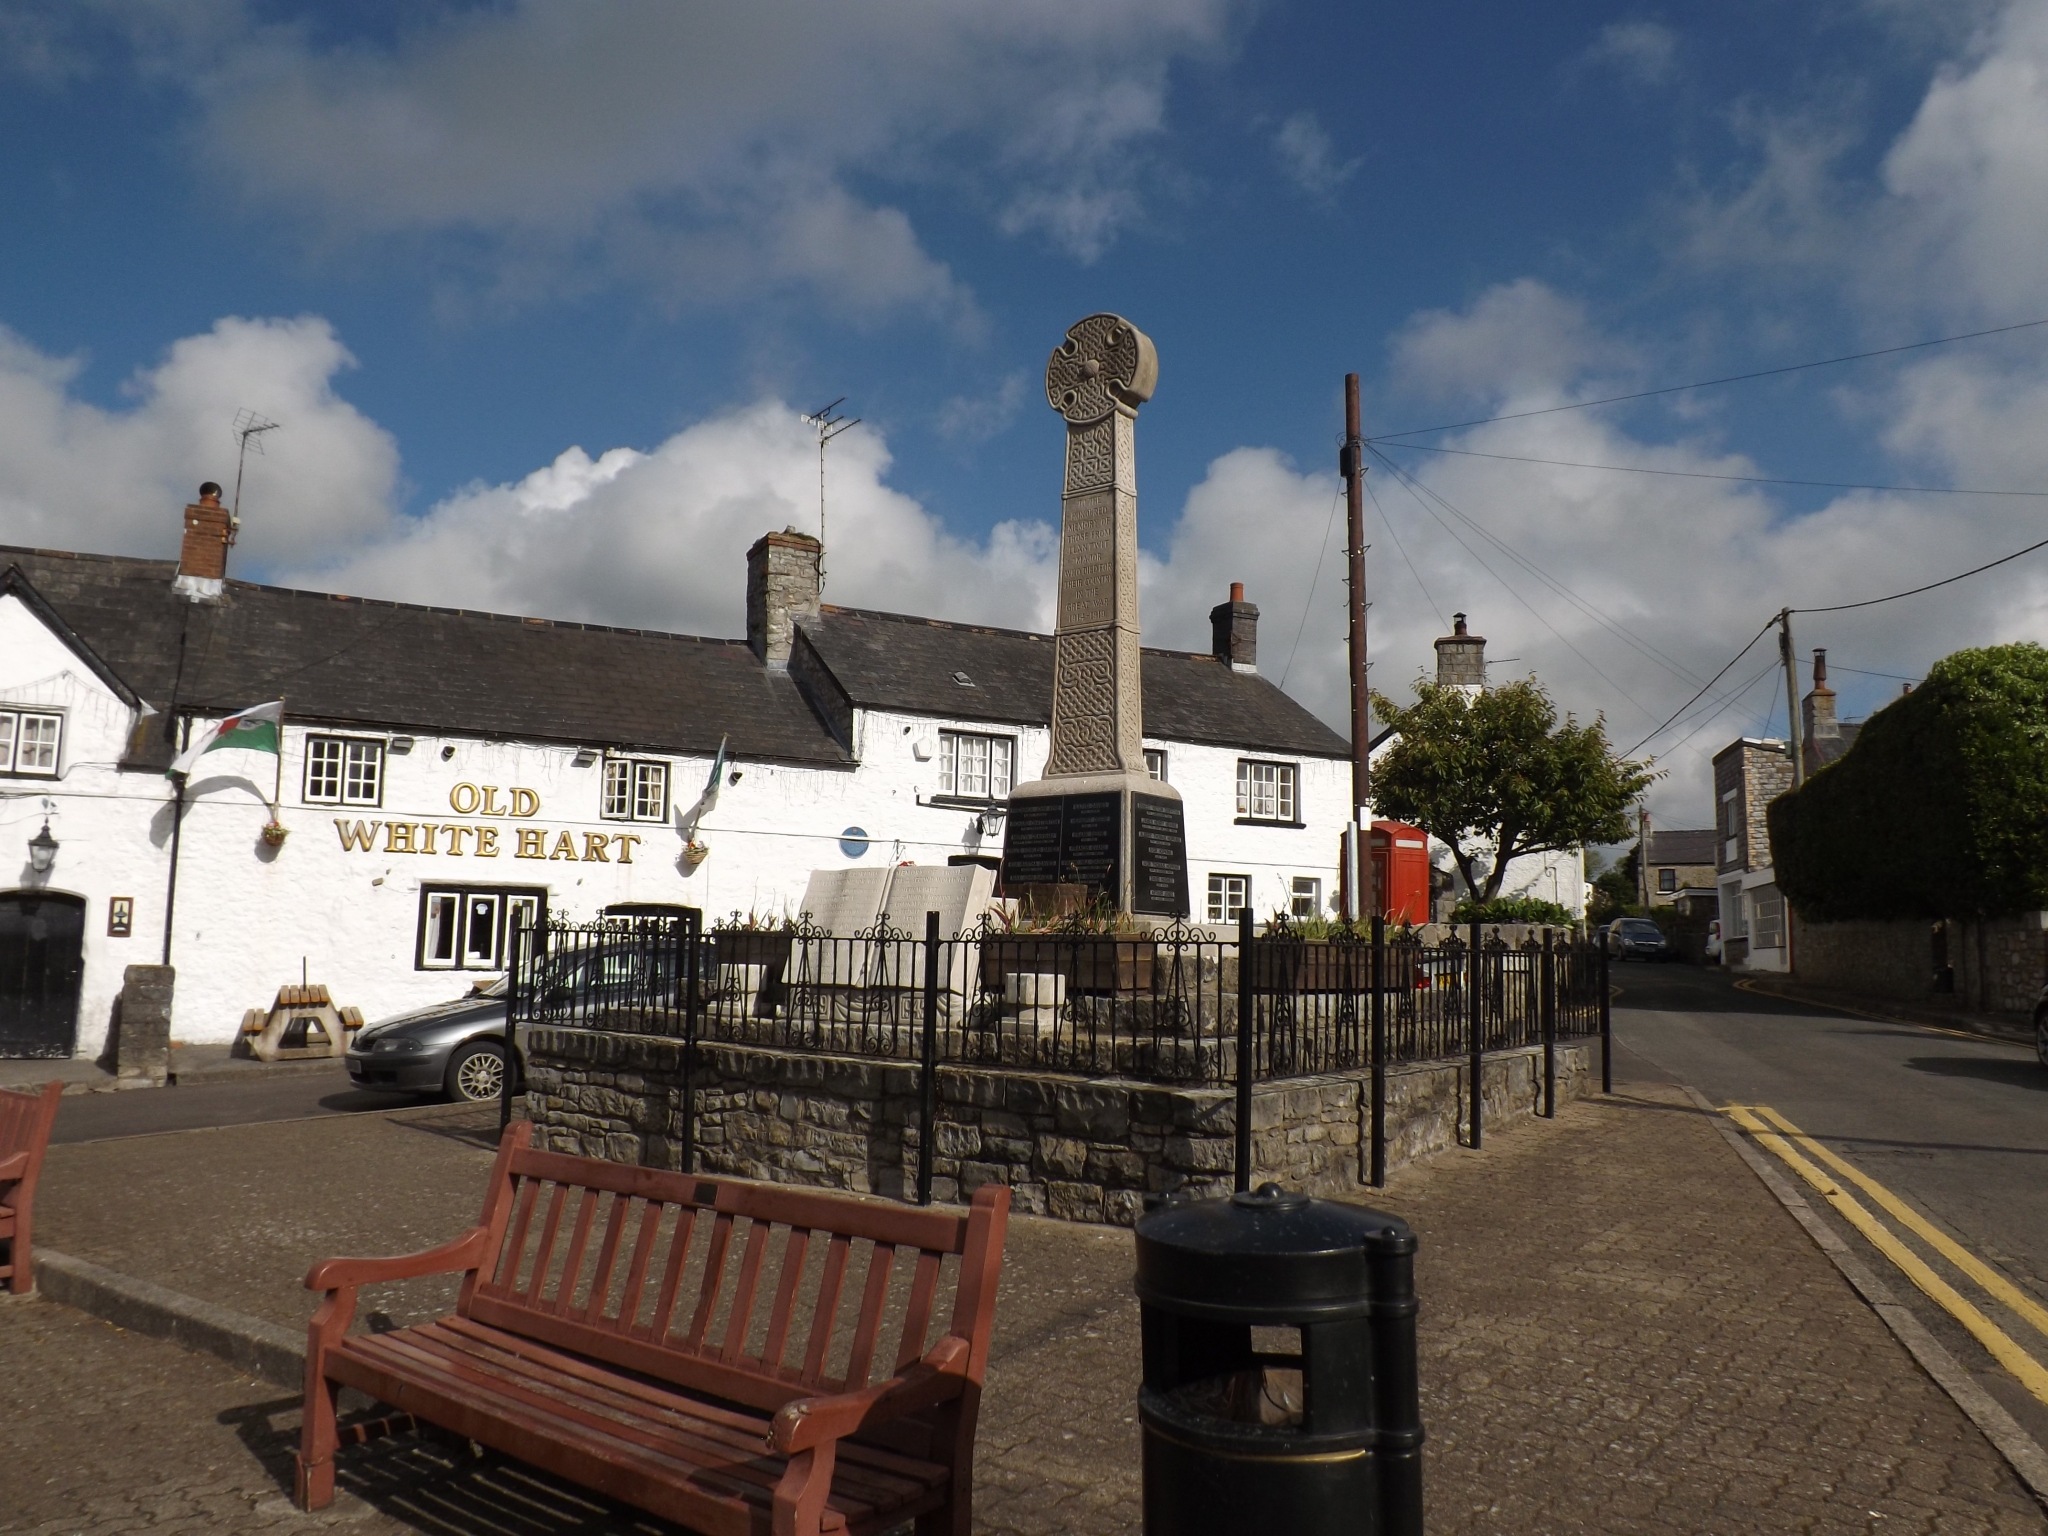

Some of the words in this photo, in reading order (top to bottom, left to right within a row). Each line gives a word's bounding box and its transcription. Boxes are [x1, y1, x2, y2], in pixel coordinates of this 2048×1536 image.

[1089, 495, 1102, 506] THE
[1070, 506, 1108, 520] HONOURED
[1067, 519, 1098, 532] MEMORY
[1100, 516, 1110, 526] OF
[1067, 532, 1088, 544] THOSE
[1091, 528, 1111, 539] FROM
[1068, 540, 1109, 555] LLANTWIT
[1075, 552, 1102, 564] MAJOR
[1064, 567, 1082, 578] WHO
[1083, 564, 1099, 576] DIED
[1099, 562, 1113, 573] FOR
[1064, 578, 1083, 589] THEIR
[1075, 589, 1083, 599] IN
[1085, 587, 1099, 598] THE
[1065, 600, 1091, 612] GREAT
[1092, 597, 1109, 608] WAR
[449, 782, 541, 817] OLD
[333, 818, 500, 858] WHITE
[514, 828, 641, 864] HART
